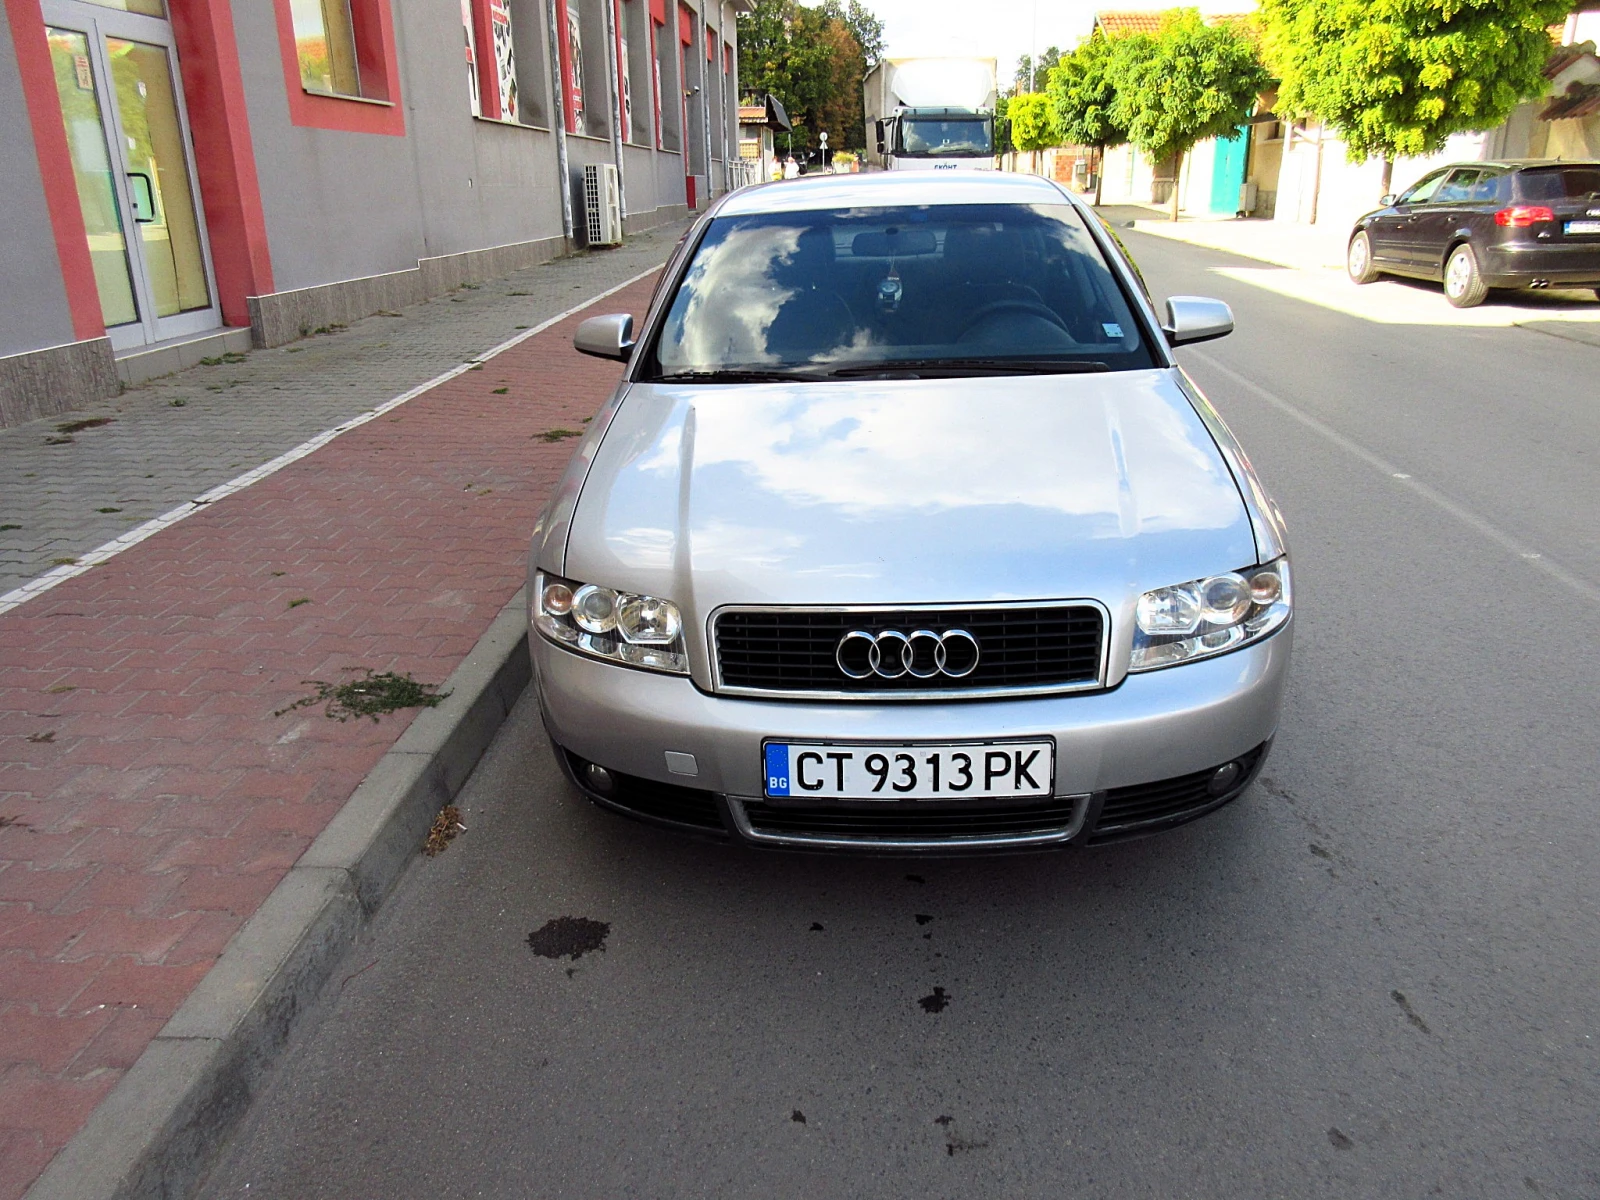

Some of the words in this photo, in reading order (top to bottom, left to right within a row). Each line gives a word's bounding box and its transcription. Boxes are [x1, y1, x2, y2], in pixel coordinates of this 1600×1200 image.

[769, 776, 788, 789] BG
[796, 751, 853, 791] CT
[864, 752, 973, 792] 9313
[984, 749, 1041, 791] PK
